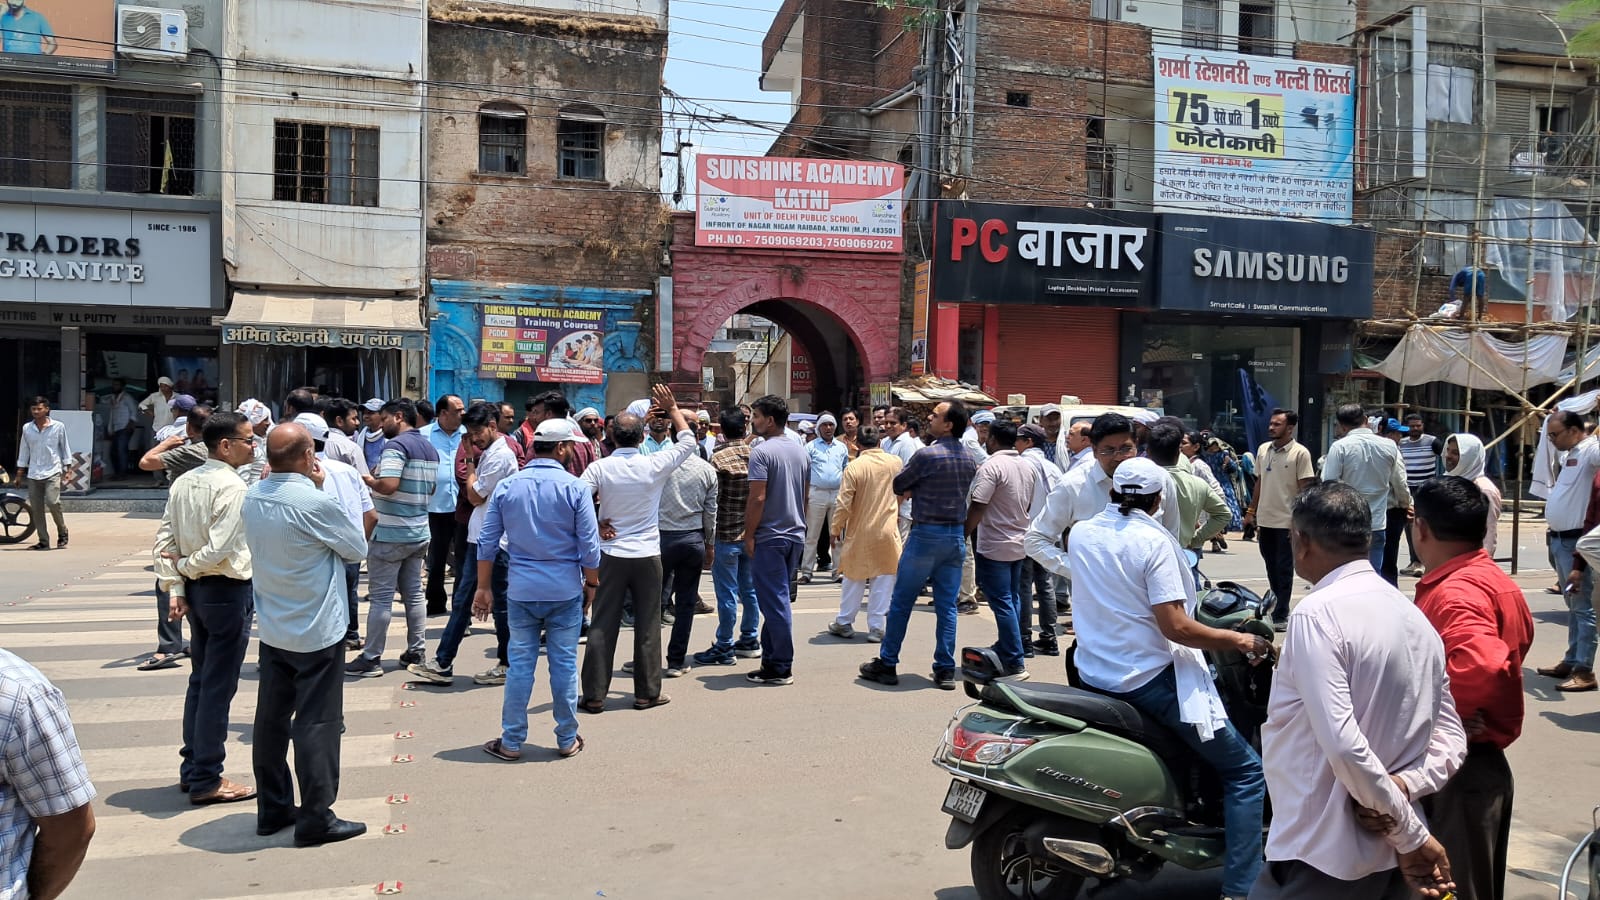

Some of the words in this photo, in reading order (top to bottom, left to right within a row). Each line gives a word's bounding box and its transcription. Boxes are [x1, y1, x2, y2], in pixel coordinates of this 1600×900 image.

[1158, 54, 1191, 79] शर्मा
[1194, 56, 1250, 85] स्टेशनरी
[1275, 67, 1310, 91] मल्टी
[1313, 68, 1351, 94] प्रिंटर्स
[1173, 91, 1209, 125] 75
[1228, 109, 1242, 125] प्रति
[1246, 98, 1260, 130] 1
[1176, 126, 1277, 153] फोटोकापी
[706, 158, 802, 182] SUNSHINE
[806, 162, 896, 187] ACADEMY
[774, 187, 830, 210] KATNI
[147, 223, 170, 231] SINCE
[178, 224, 197, 232] 1986
[705, 221, 736, 229] INFRONT
[748, 222, 771, 230] NAGAR
[743, 211, 762, 220] UNIT
[764, 212, 774, 220] OF
[776, 213, 798, 221] DELHI
[800, 213, 828, 222] PUBLIC
[830, 215, 859, 224] SCHOOL
[0, 231, 141, 257] RADERS
[951, 217, 1009, 263] PC
[1016, 221, 1148, 271] बाजार
[0, 257, 145, 283] GRANITE
[1193, 247, 1349, 284] SAMSUNG
[1047, 285, 1065, 293] Laptop
[84, 312, 118, 324] PUTTY
[484, 304, 515, 315] DIKSHA
[563, 309, 602, 320] ACADEMY
[1253, 303, 1277, 311] Swastik
[1278, 304, 1328, 313] Communication
[133, 314, 181, 326] SANITARY
[183, 315, 212, 327] WARE
[524, 318, 560, 329] Training
[563, 320, 599, 330] Courses
[226, 325, 271, 343] अमित
[274, 327, 329, 345] स्टेशनरी
[341, 331, 364, 346] राय
[369, 330, 403, 346] लॉज
